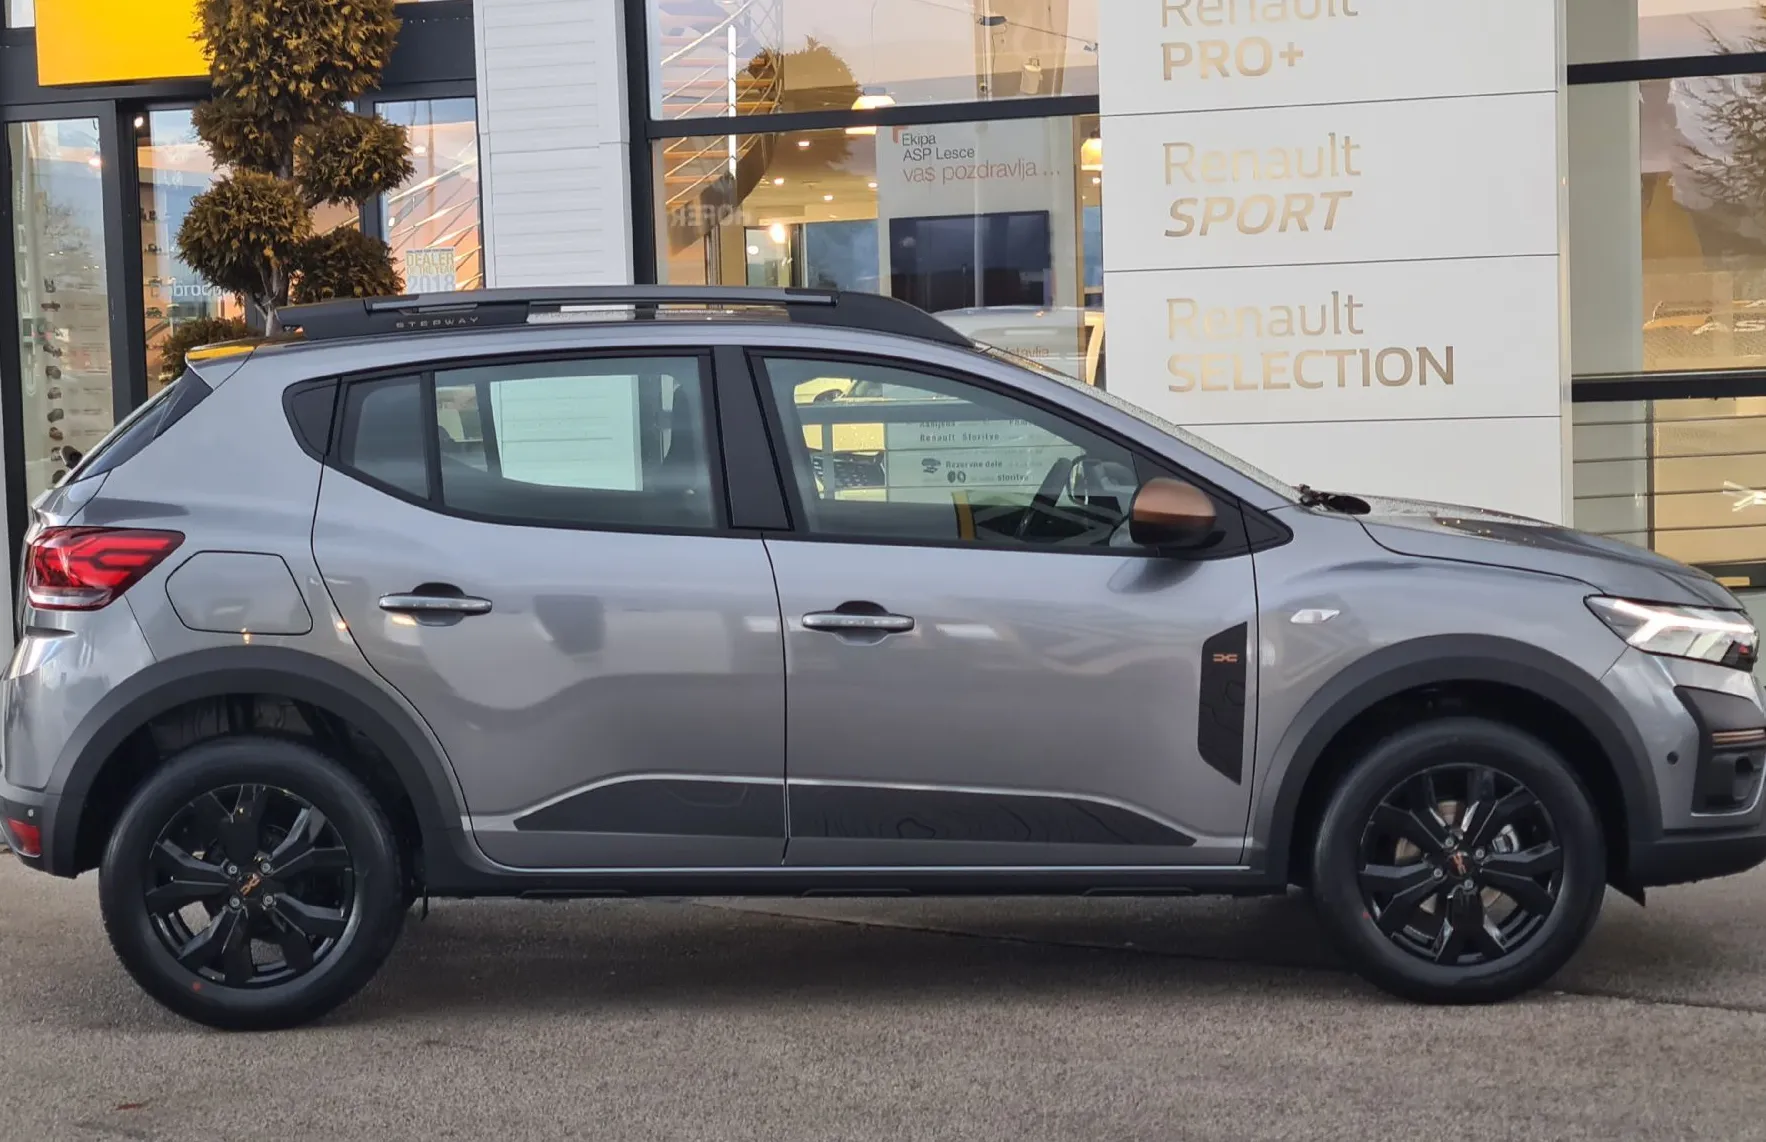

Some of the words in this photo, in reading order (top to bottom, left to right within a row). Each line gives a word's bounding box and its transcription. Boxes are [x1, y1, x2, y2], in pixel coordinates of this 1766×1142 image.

[1161, 36, 1304, 81] PRO+
[902, 132, 937, 148] Ekipa
[903, 148, 932, 162] ASP
[936, 147, 975, 161] Lesce
[1162, 132, 1362, 185] Renault
[942, 158, 1037, 184] pozdravlja
[1164, 190, 1353, 237] SPORT
[406, 251, 454, 267] DEALER
[407, 274, 455, 293] 2018
[396, 317, 478, 328] STEPWAY
[1167, 290, 1364, 341] Renault
[1167, 345, 1455, 393] SELECTION
